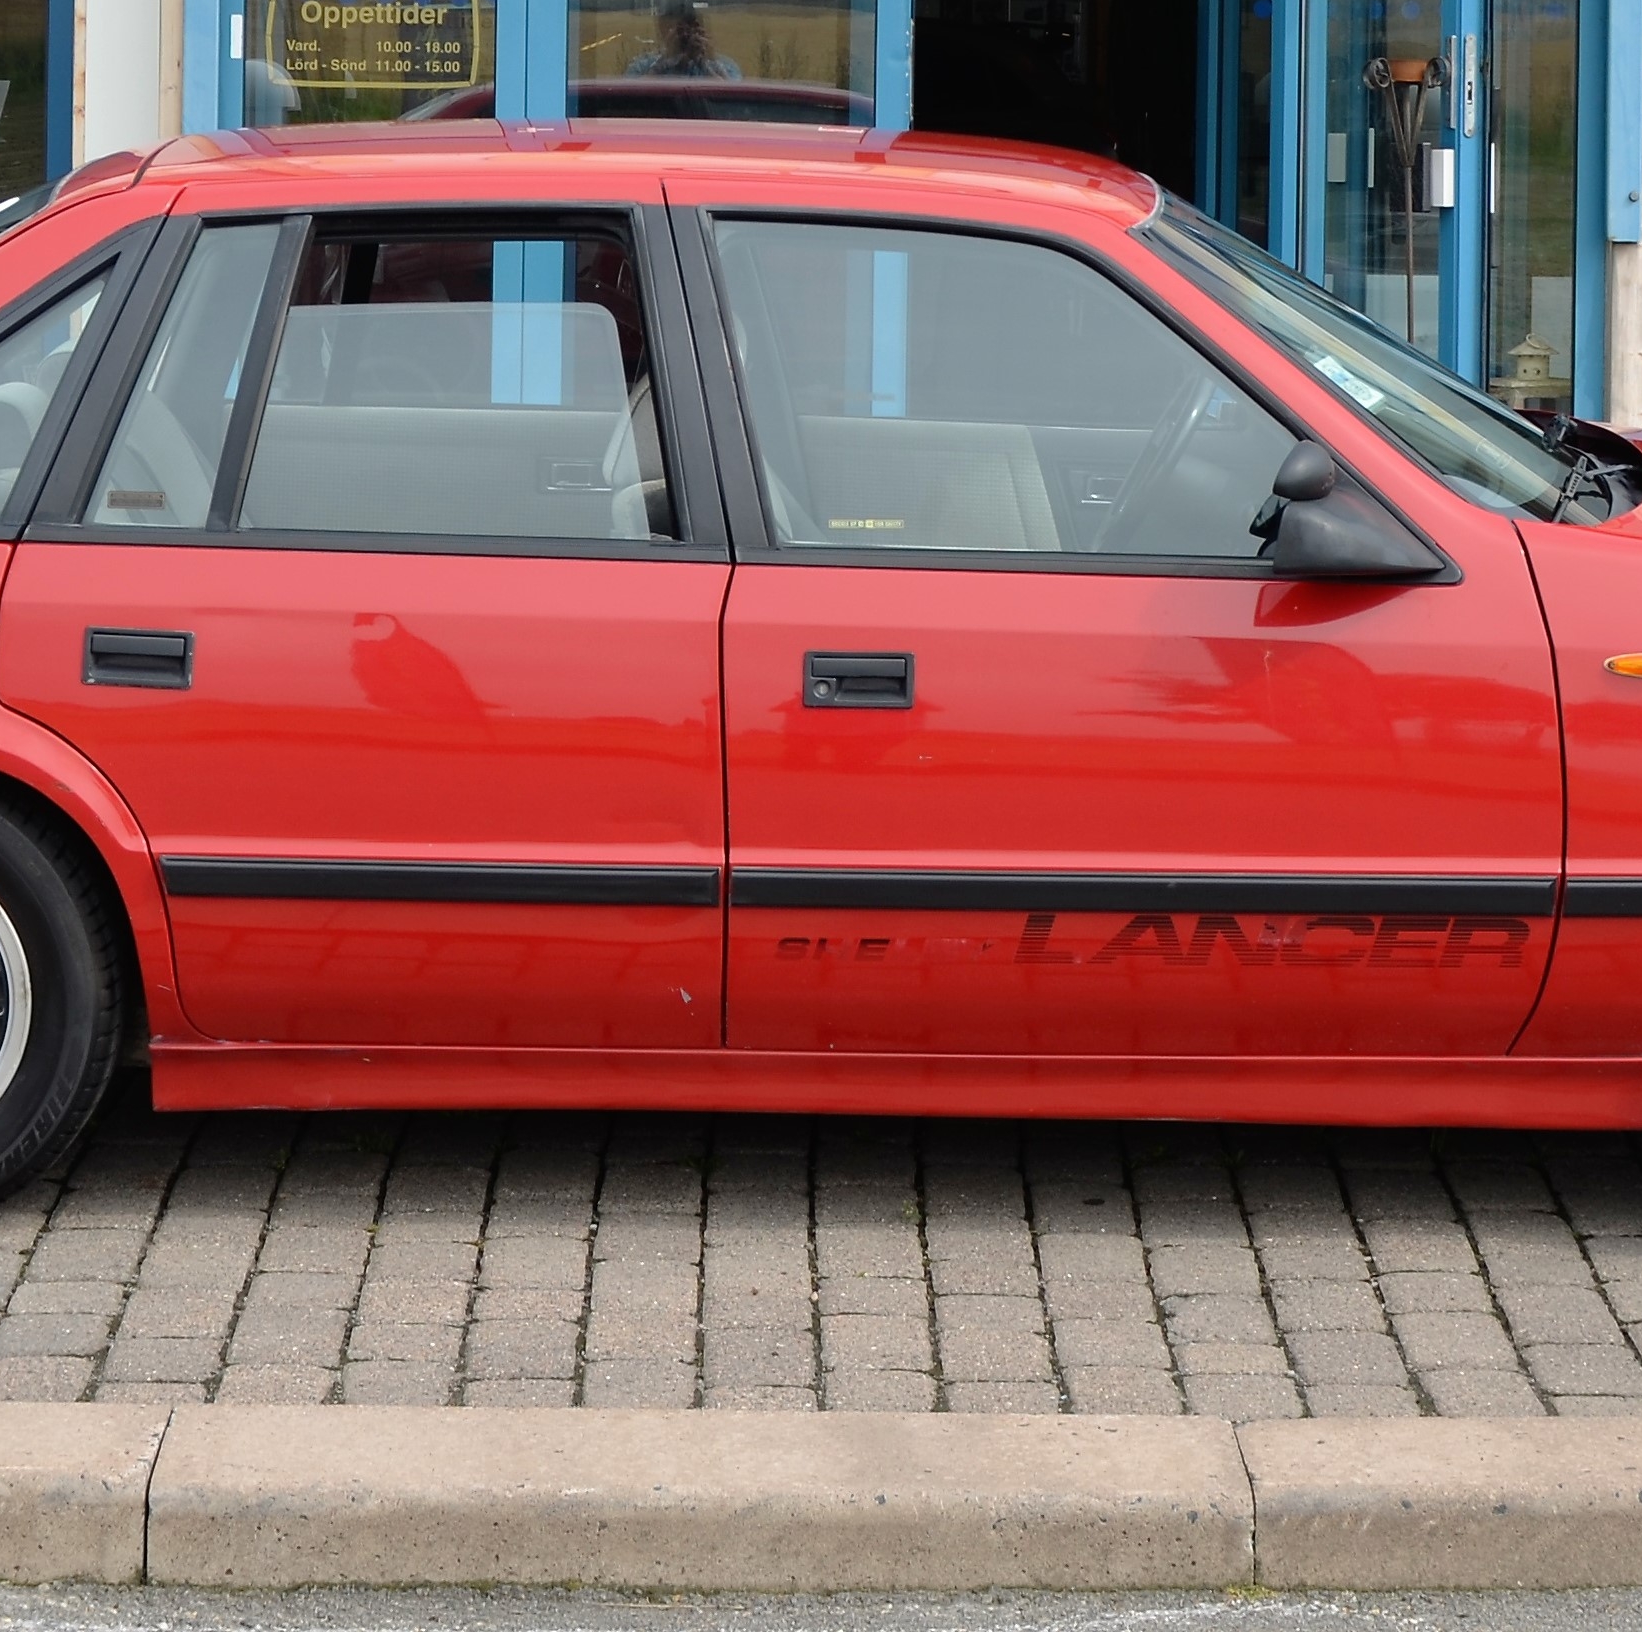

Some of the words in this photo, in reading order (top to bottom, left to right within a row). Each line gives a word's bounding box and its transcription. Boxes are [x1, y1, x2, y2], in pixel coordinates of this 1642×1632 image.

[286, 39, 321, 52] Vard.
[375, 41, 411, 53] 10.00
[425, 42, 461, 54] 18.00
[286, 58, 318, 71] Lörd
[331, 60, 367, 72] Sönd
[375, 60, 411, 72] 11.00
[425, 60, 461, 73] 15.00
[1013, 913, 1531, 968] LANCER
